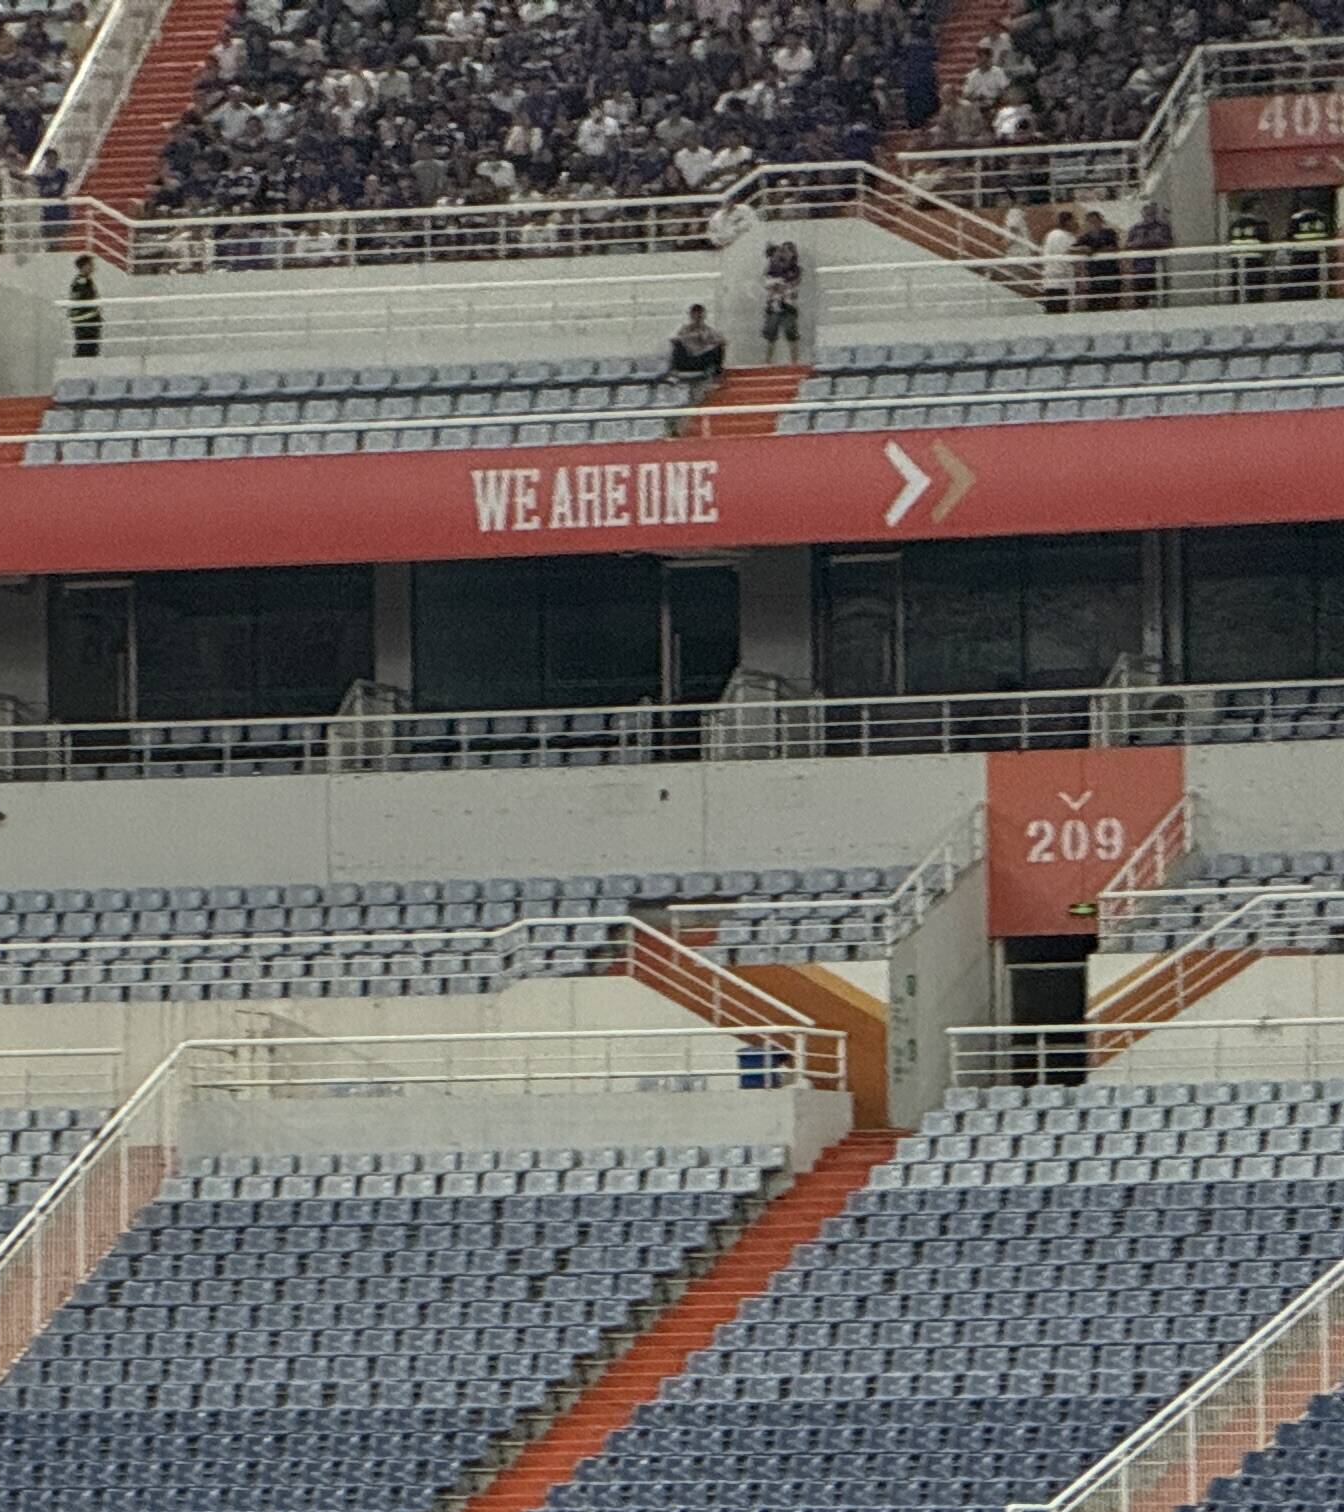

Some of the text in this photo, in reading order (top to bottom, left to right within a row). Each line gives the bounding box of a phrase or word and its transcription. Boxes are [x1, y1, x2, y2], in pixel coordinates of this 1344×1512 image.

[470, 461, 718, 532] WE ARE ONE
[1027, 818, 1126, 864] 209
